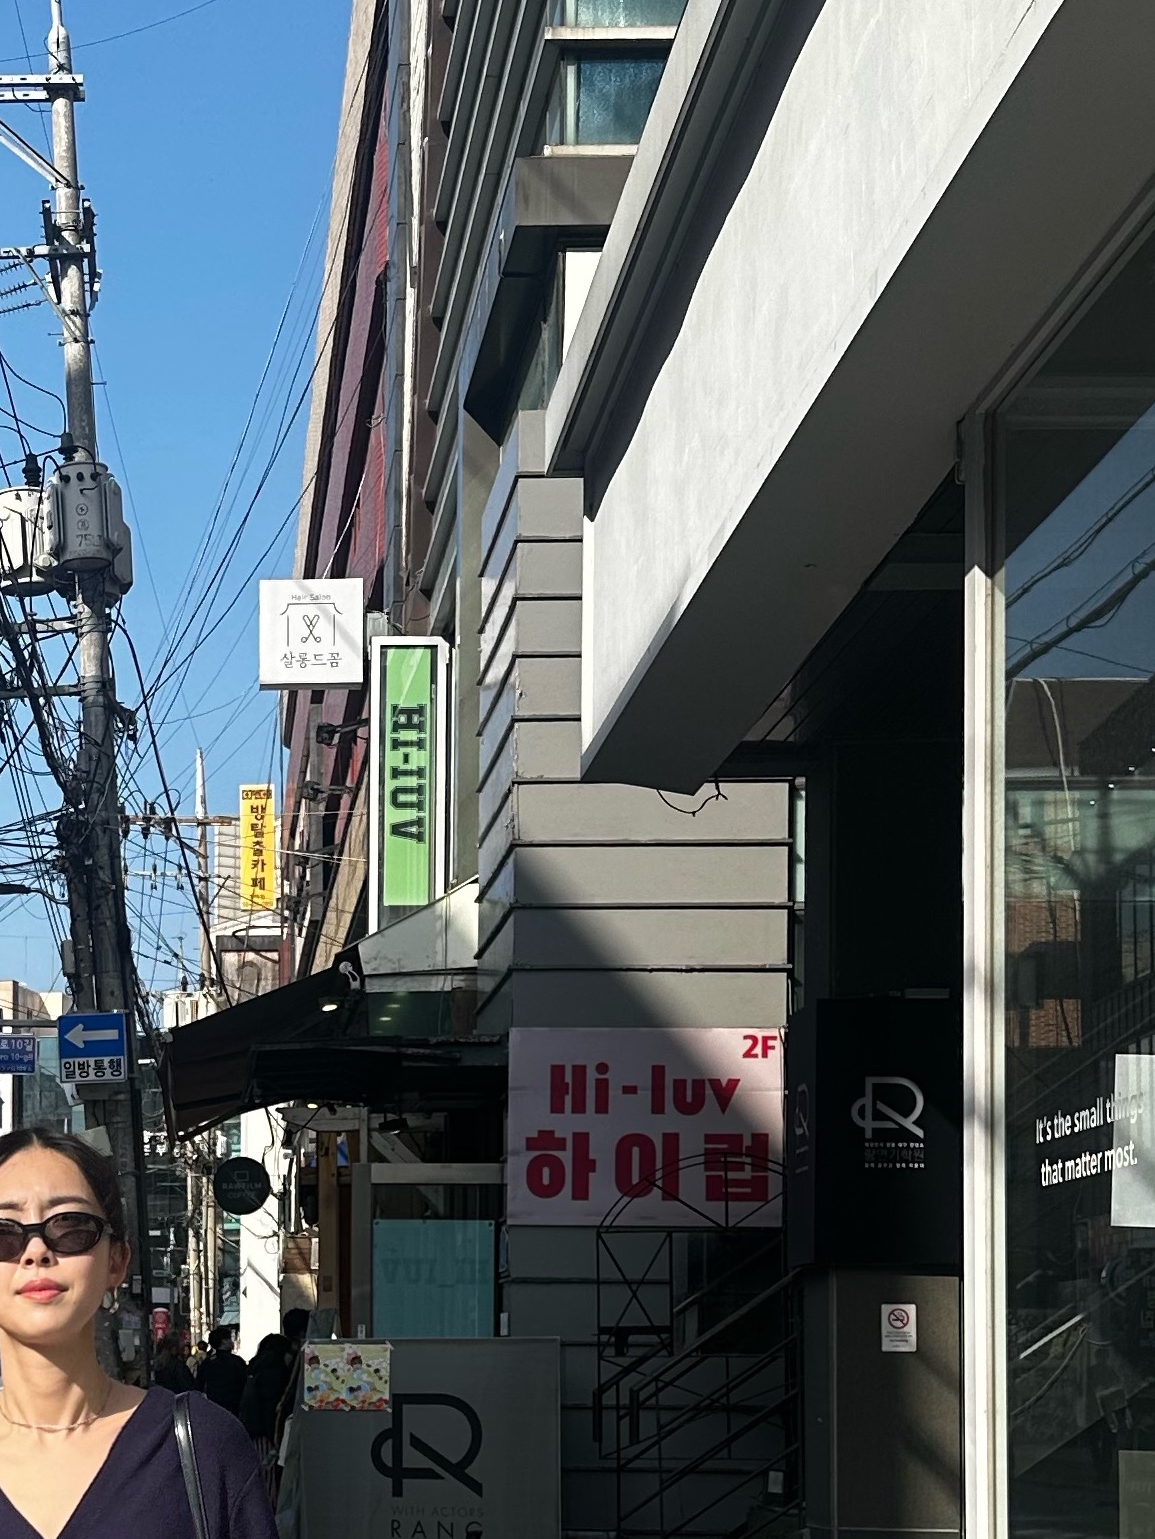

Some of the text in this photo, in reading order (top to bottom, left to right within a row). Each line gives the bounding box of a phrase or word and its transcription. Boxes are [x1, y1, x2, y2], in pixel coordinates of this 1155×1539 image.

[742, 1035, 778, 1059] 2F
[63, 1058, 123, 1080] 일방통행
[550, 1062, 741, 1115] Hi-luv
[1035, 1115, 1052, 1145] It's
[1053, 1109, 1072, 1139] the
[1073, 1096, 1104, 1133] small
[1041, 1158, 1063, 1187] that
[1065, 1151, 1103, 1181] matter
[391, 1506, 484, 1517] WITH ACTORS
